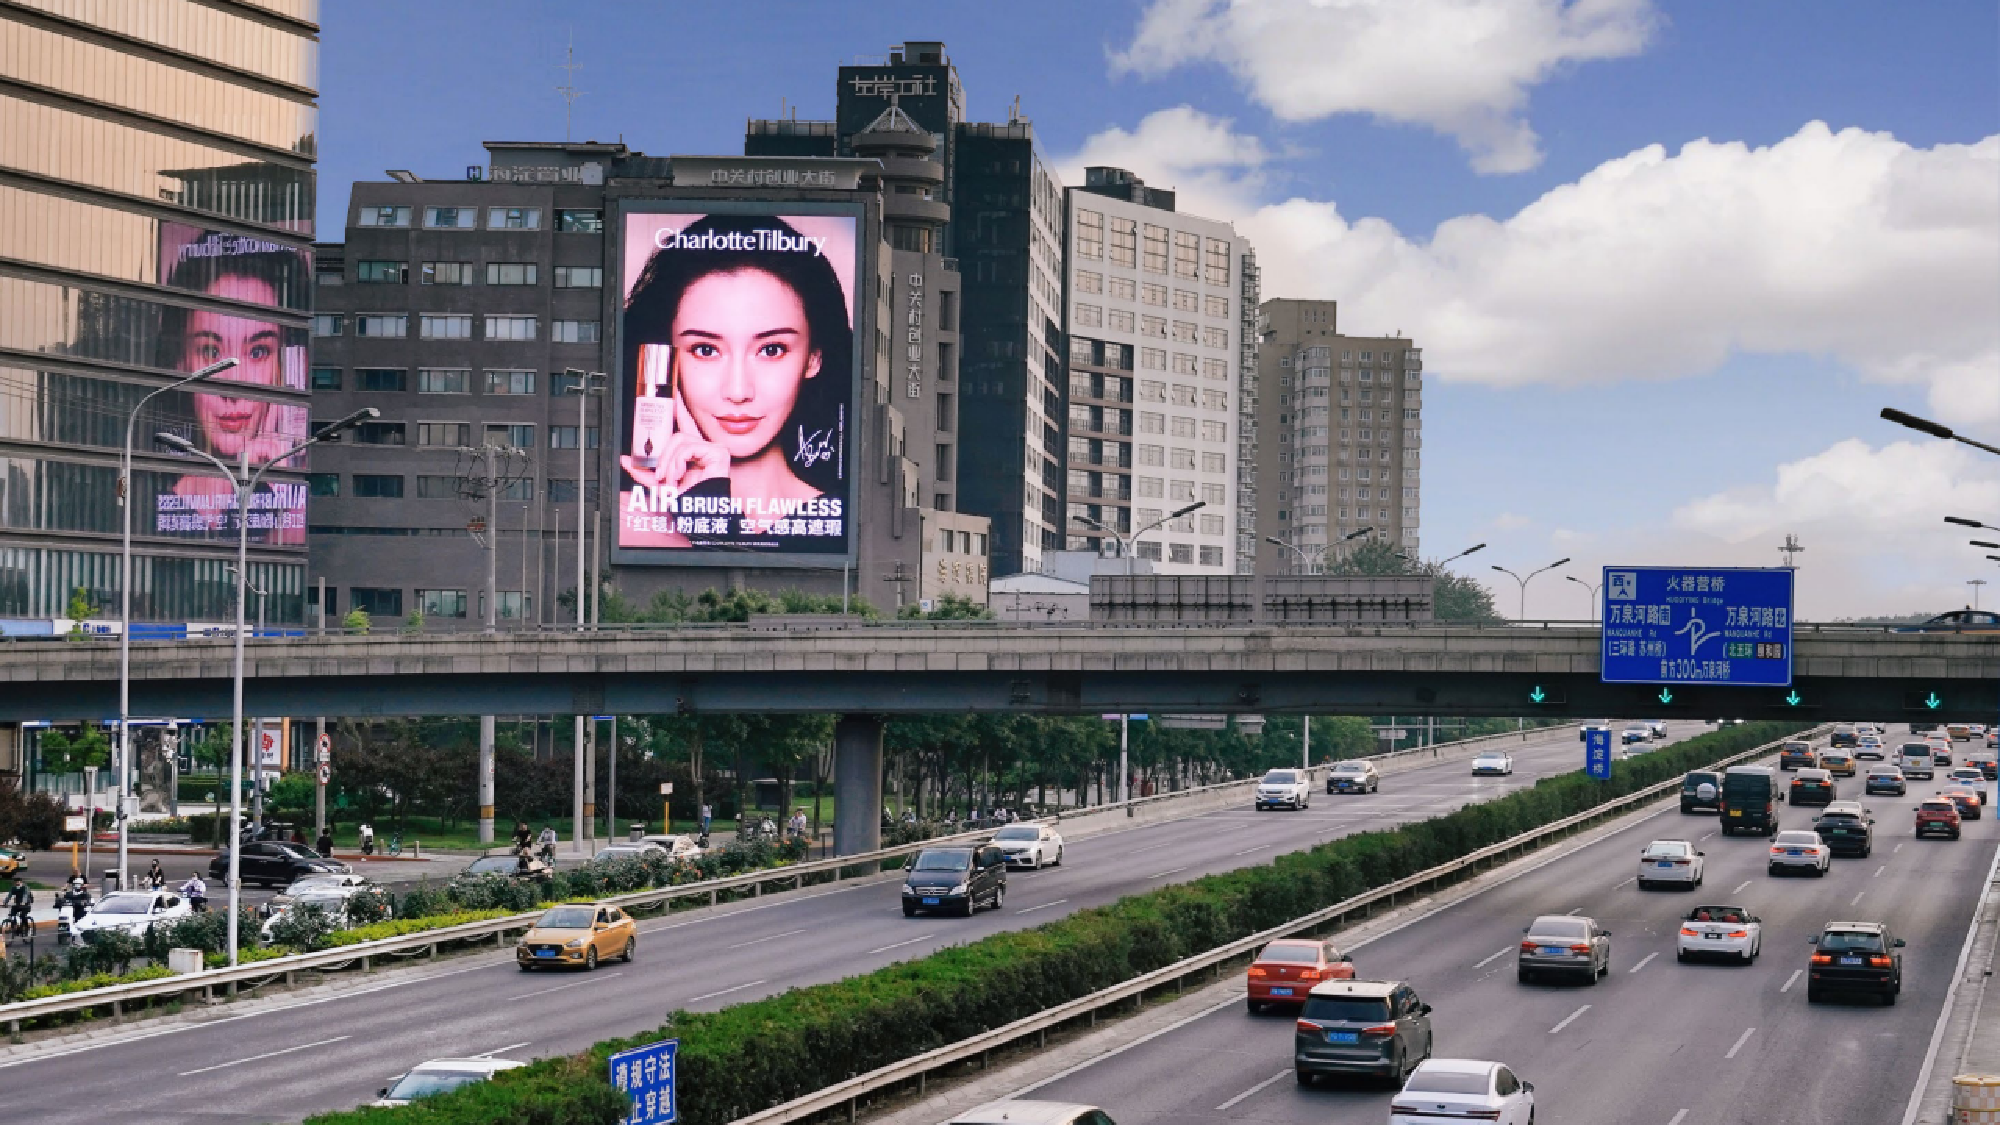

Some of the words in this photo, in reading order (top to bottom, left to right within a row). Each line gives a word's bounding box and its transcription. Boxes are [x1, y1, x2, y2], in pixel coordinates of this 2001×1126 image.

[711, 169, 835, 185] 中关村创业大街
[908, 272, 922, 398] 中关村创业大街
[627, 485, 679, 513] AIR
[682, 496, 742, 515] BRUSH
[746, 497, 842, 517] FLAWLESS
[739, 518, 842, 537] 空气感高遮瑕
[1667, 574, 1726, 592] 火器营桥
[1592, 734, 1605, 774] 海淀桥
[619, 1084, 671, 1125] 止穿越
